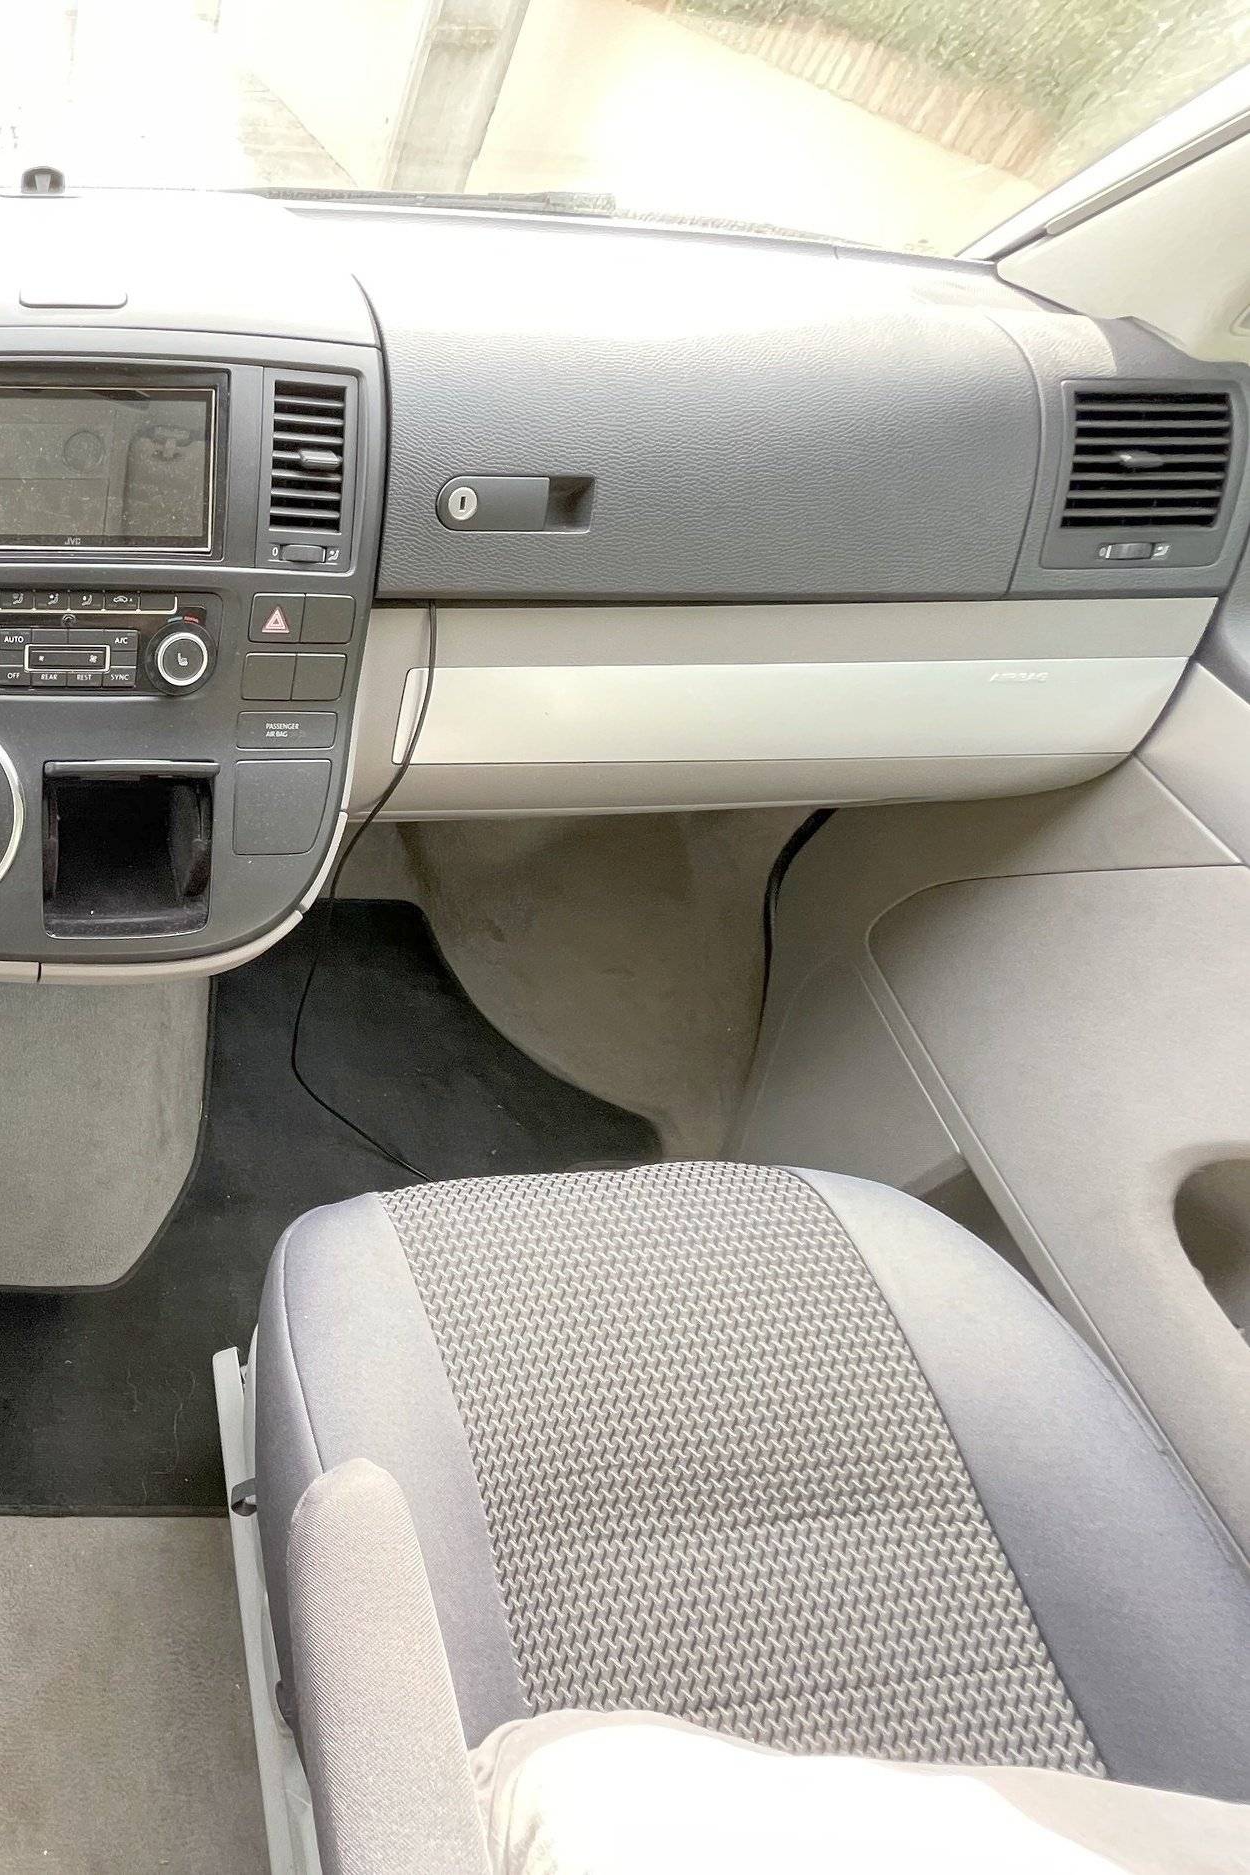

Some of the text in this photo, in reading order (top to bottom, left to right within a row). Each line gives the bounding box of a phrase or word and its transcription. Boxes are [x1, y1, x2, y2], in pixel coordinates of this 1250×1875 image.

[64, 537, 81, 546] JVC
[3, 635, 25, 644] AUTO
[114, 636, 129, 645] A/C
[7, 671, 20, 679] OFF
[40, 673, 58, 681] REAR
[76, 673, 92, 681] REST
[110, 673, 130, 681] SYNC
